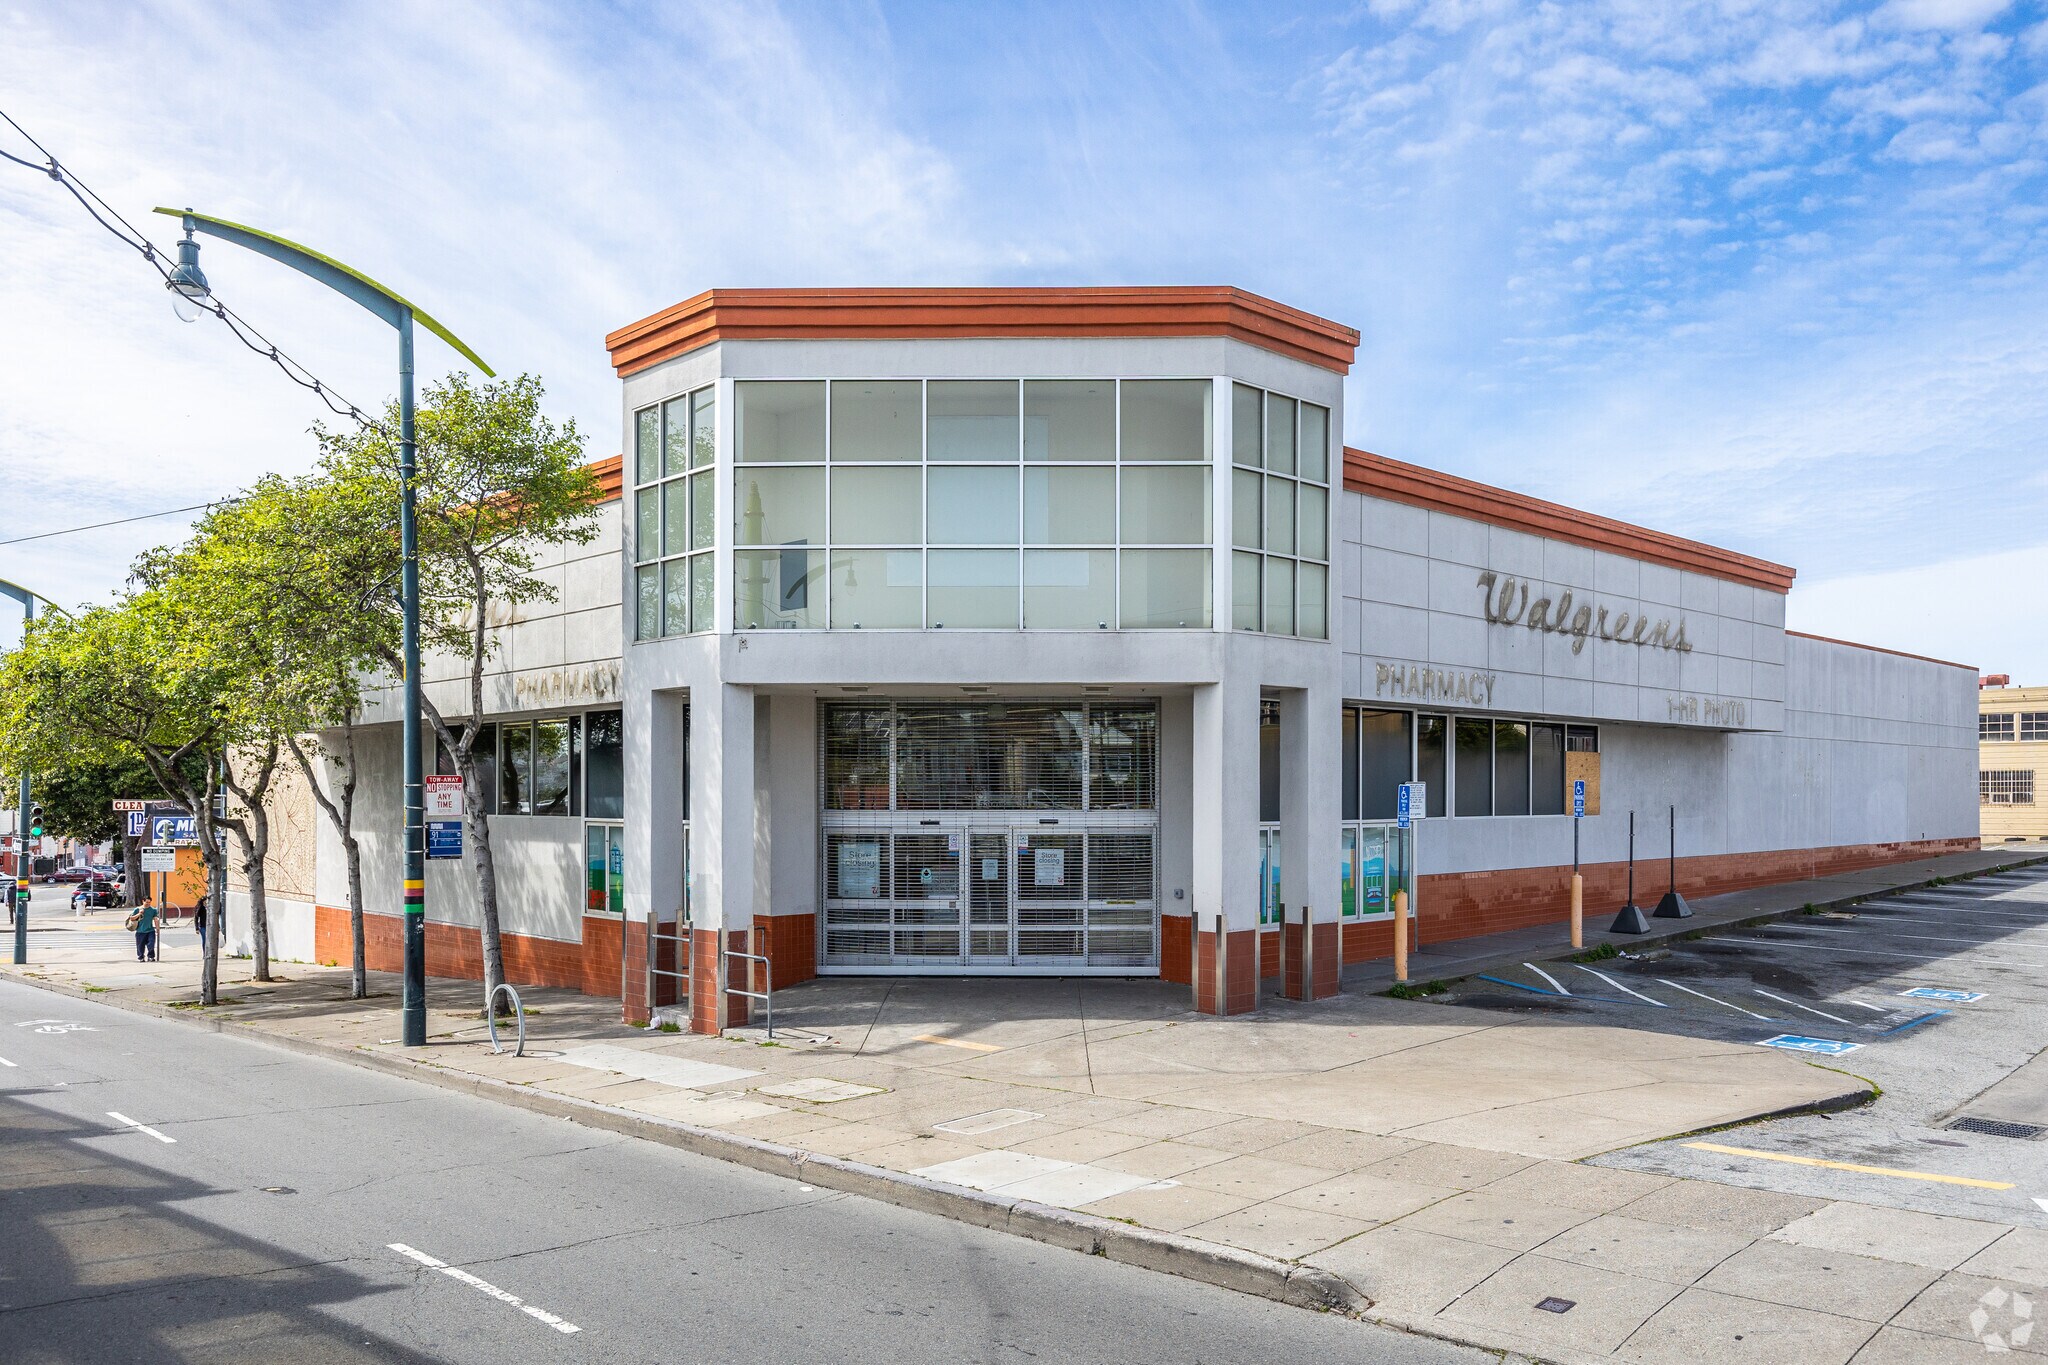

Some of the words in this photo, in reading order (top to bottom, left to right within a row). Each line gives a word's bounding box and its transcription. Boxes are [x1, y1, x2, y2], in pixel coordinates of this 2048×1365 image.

[1477, 571, 1693, 655] Walgreens
[515, 661, 621, 704] PHARMACY
[1376, 662, 1496, 705] PHARMACY
[1704, 698, 1745, 725] PHOTO
[426, 783, 437, 792] NO
[431, 831, 439, 839] 91
